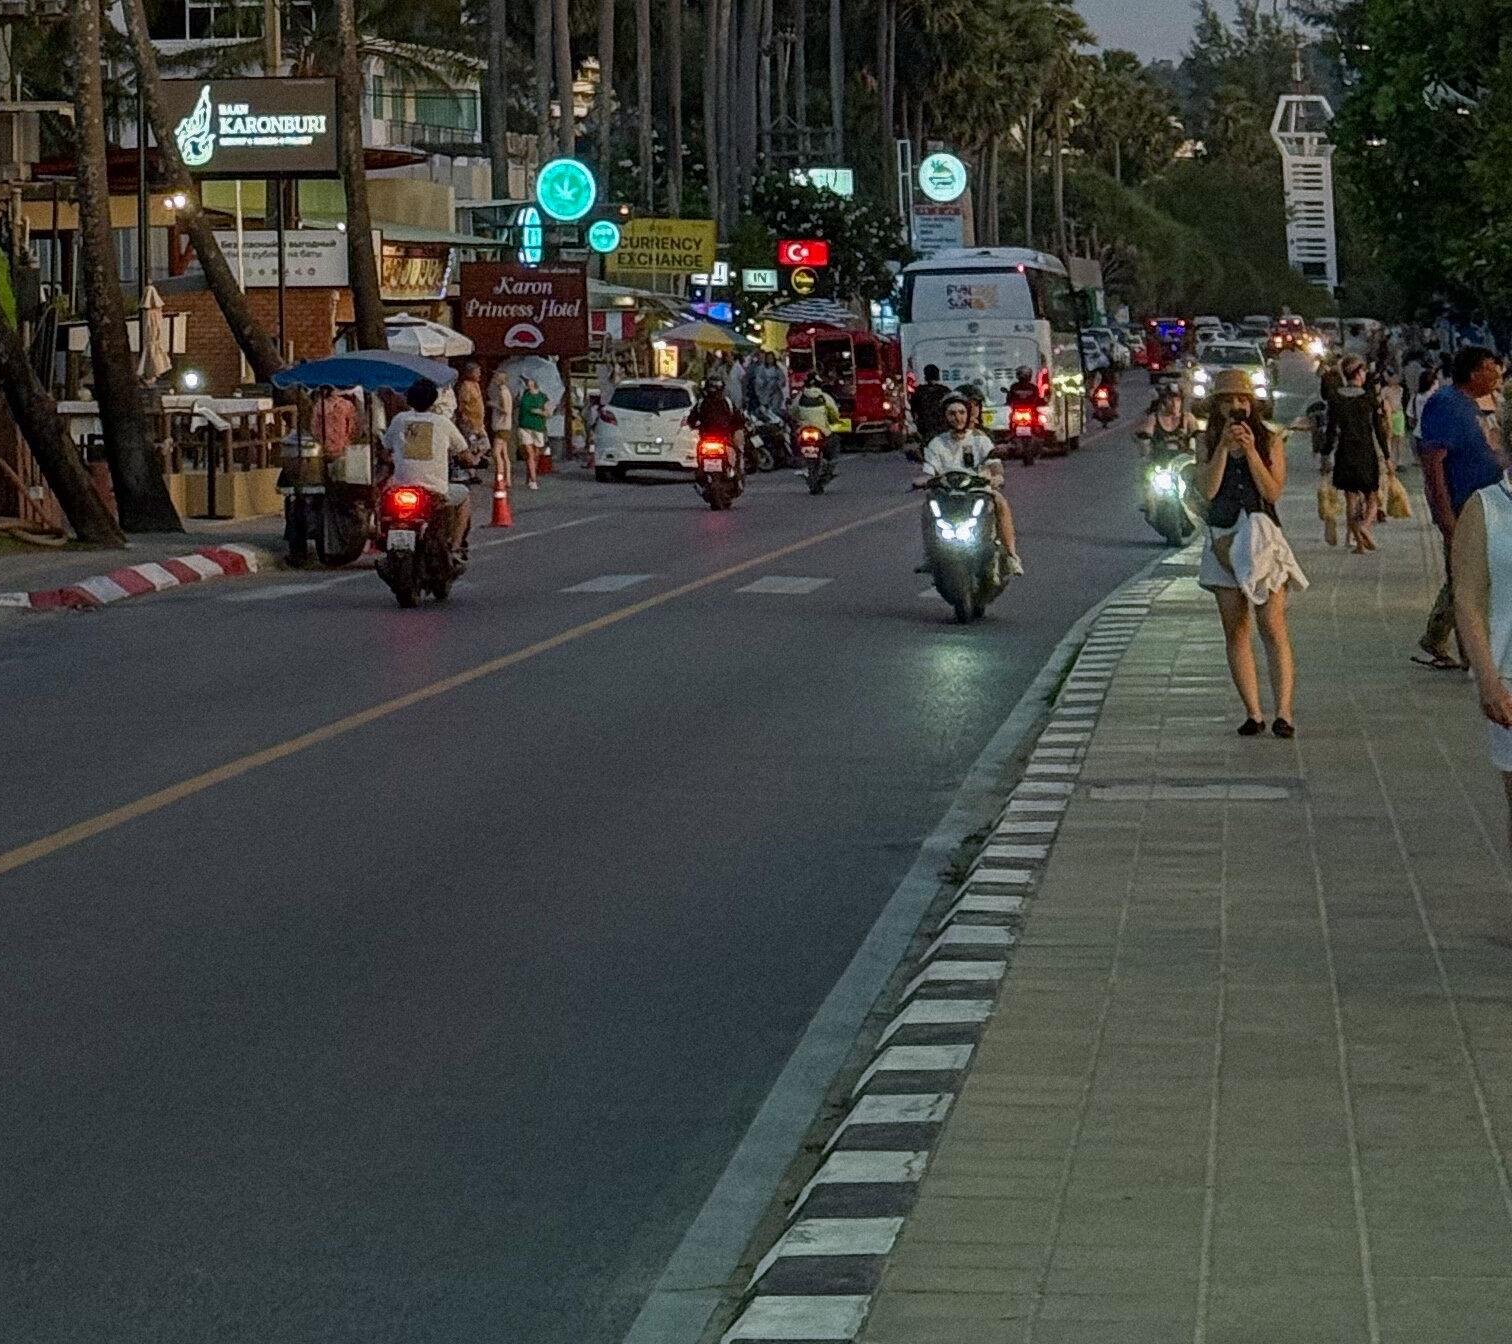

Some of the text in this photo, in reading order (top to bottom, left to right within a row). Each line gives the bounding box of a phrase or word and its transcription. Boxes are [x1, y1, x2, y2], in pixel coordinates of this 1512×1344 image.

[219, 115, 326, 135] KARONBURI
[221, 239, 278, 249] Безпасный
[619, 236, 703, 251] CURRENCY
[617, 252, 704, 267] EXCHANGE
[492, 276, 553, 295] Karon
[753, 272, 768, 284] IN
[466, 298, 582, 324] Princess Hotel
